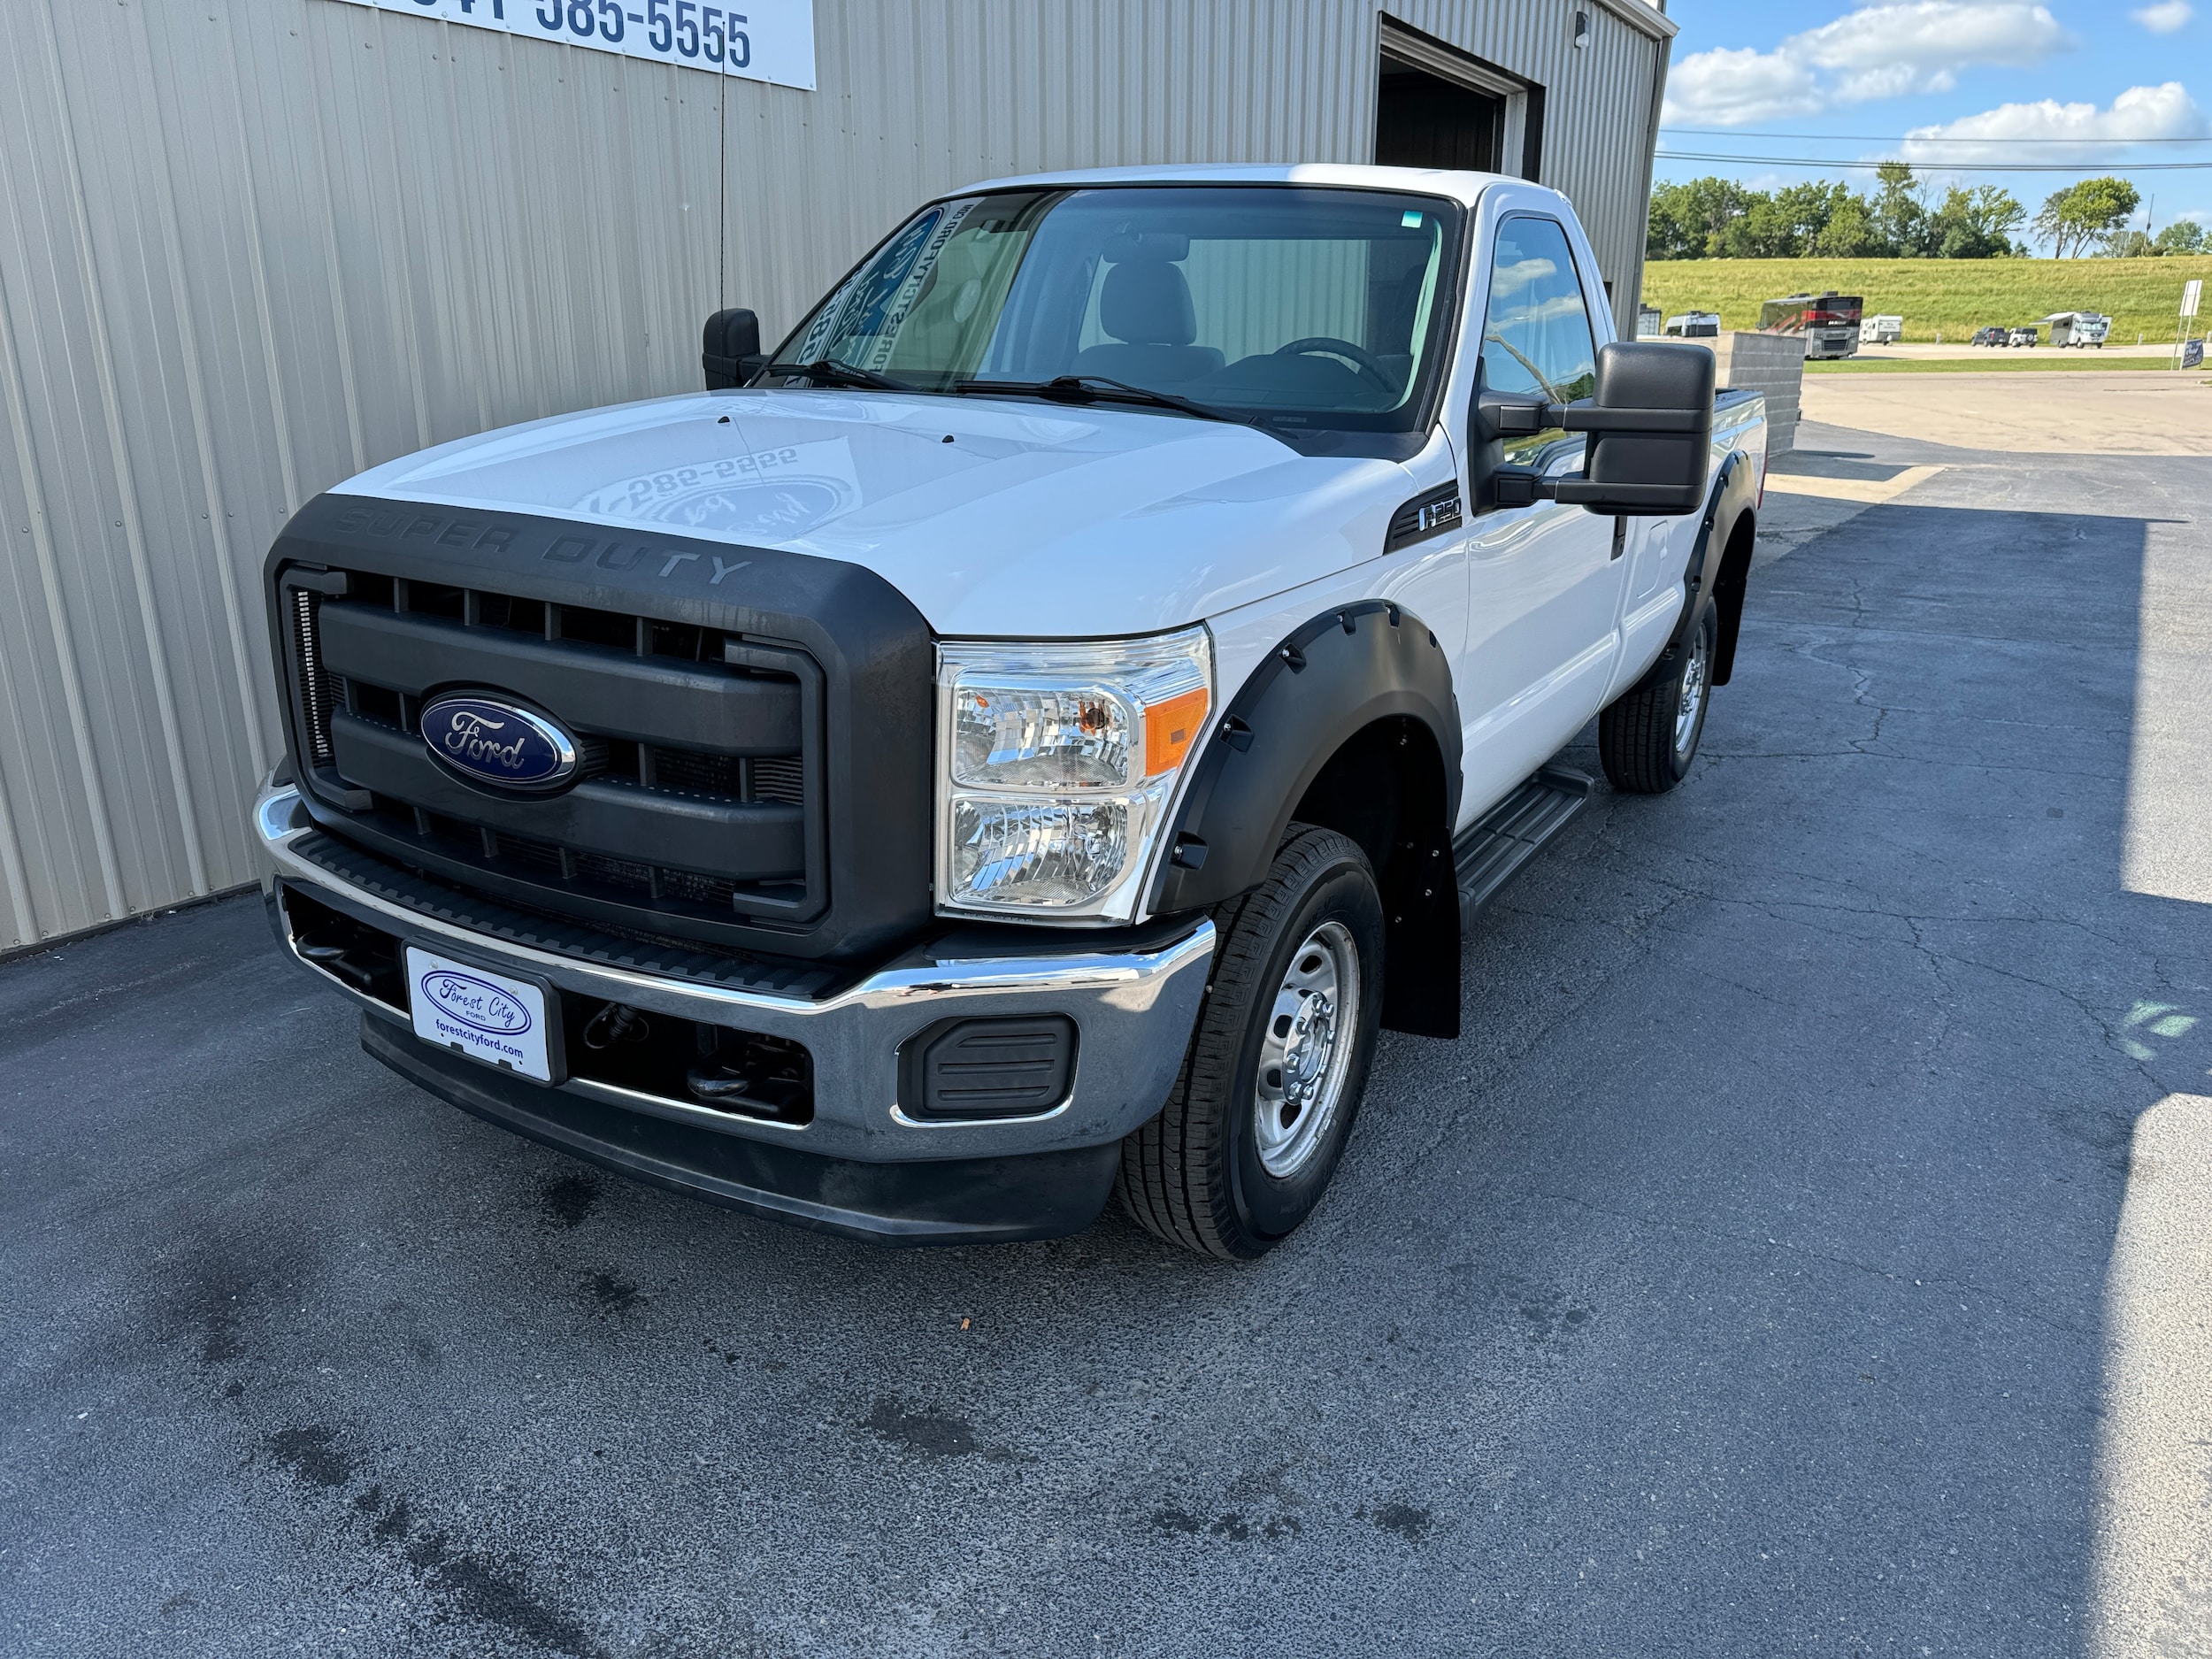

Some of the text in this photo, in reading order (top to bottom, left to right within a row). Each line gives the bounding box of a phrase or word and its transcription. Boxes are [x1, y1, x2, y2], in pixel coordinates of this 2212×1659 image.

[334, 505, 752, 586] SUPER DUTY
[445, 711, 526, 770] Ford
[440, 979, 516, 1028] Forest City
[465, 1010, 487, 1022] FORD
[435, 1018, 524, 1058] forestcityford.com
